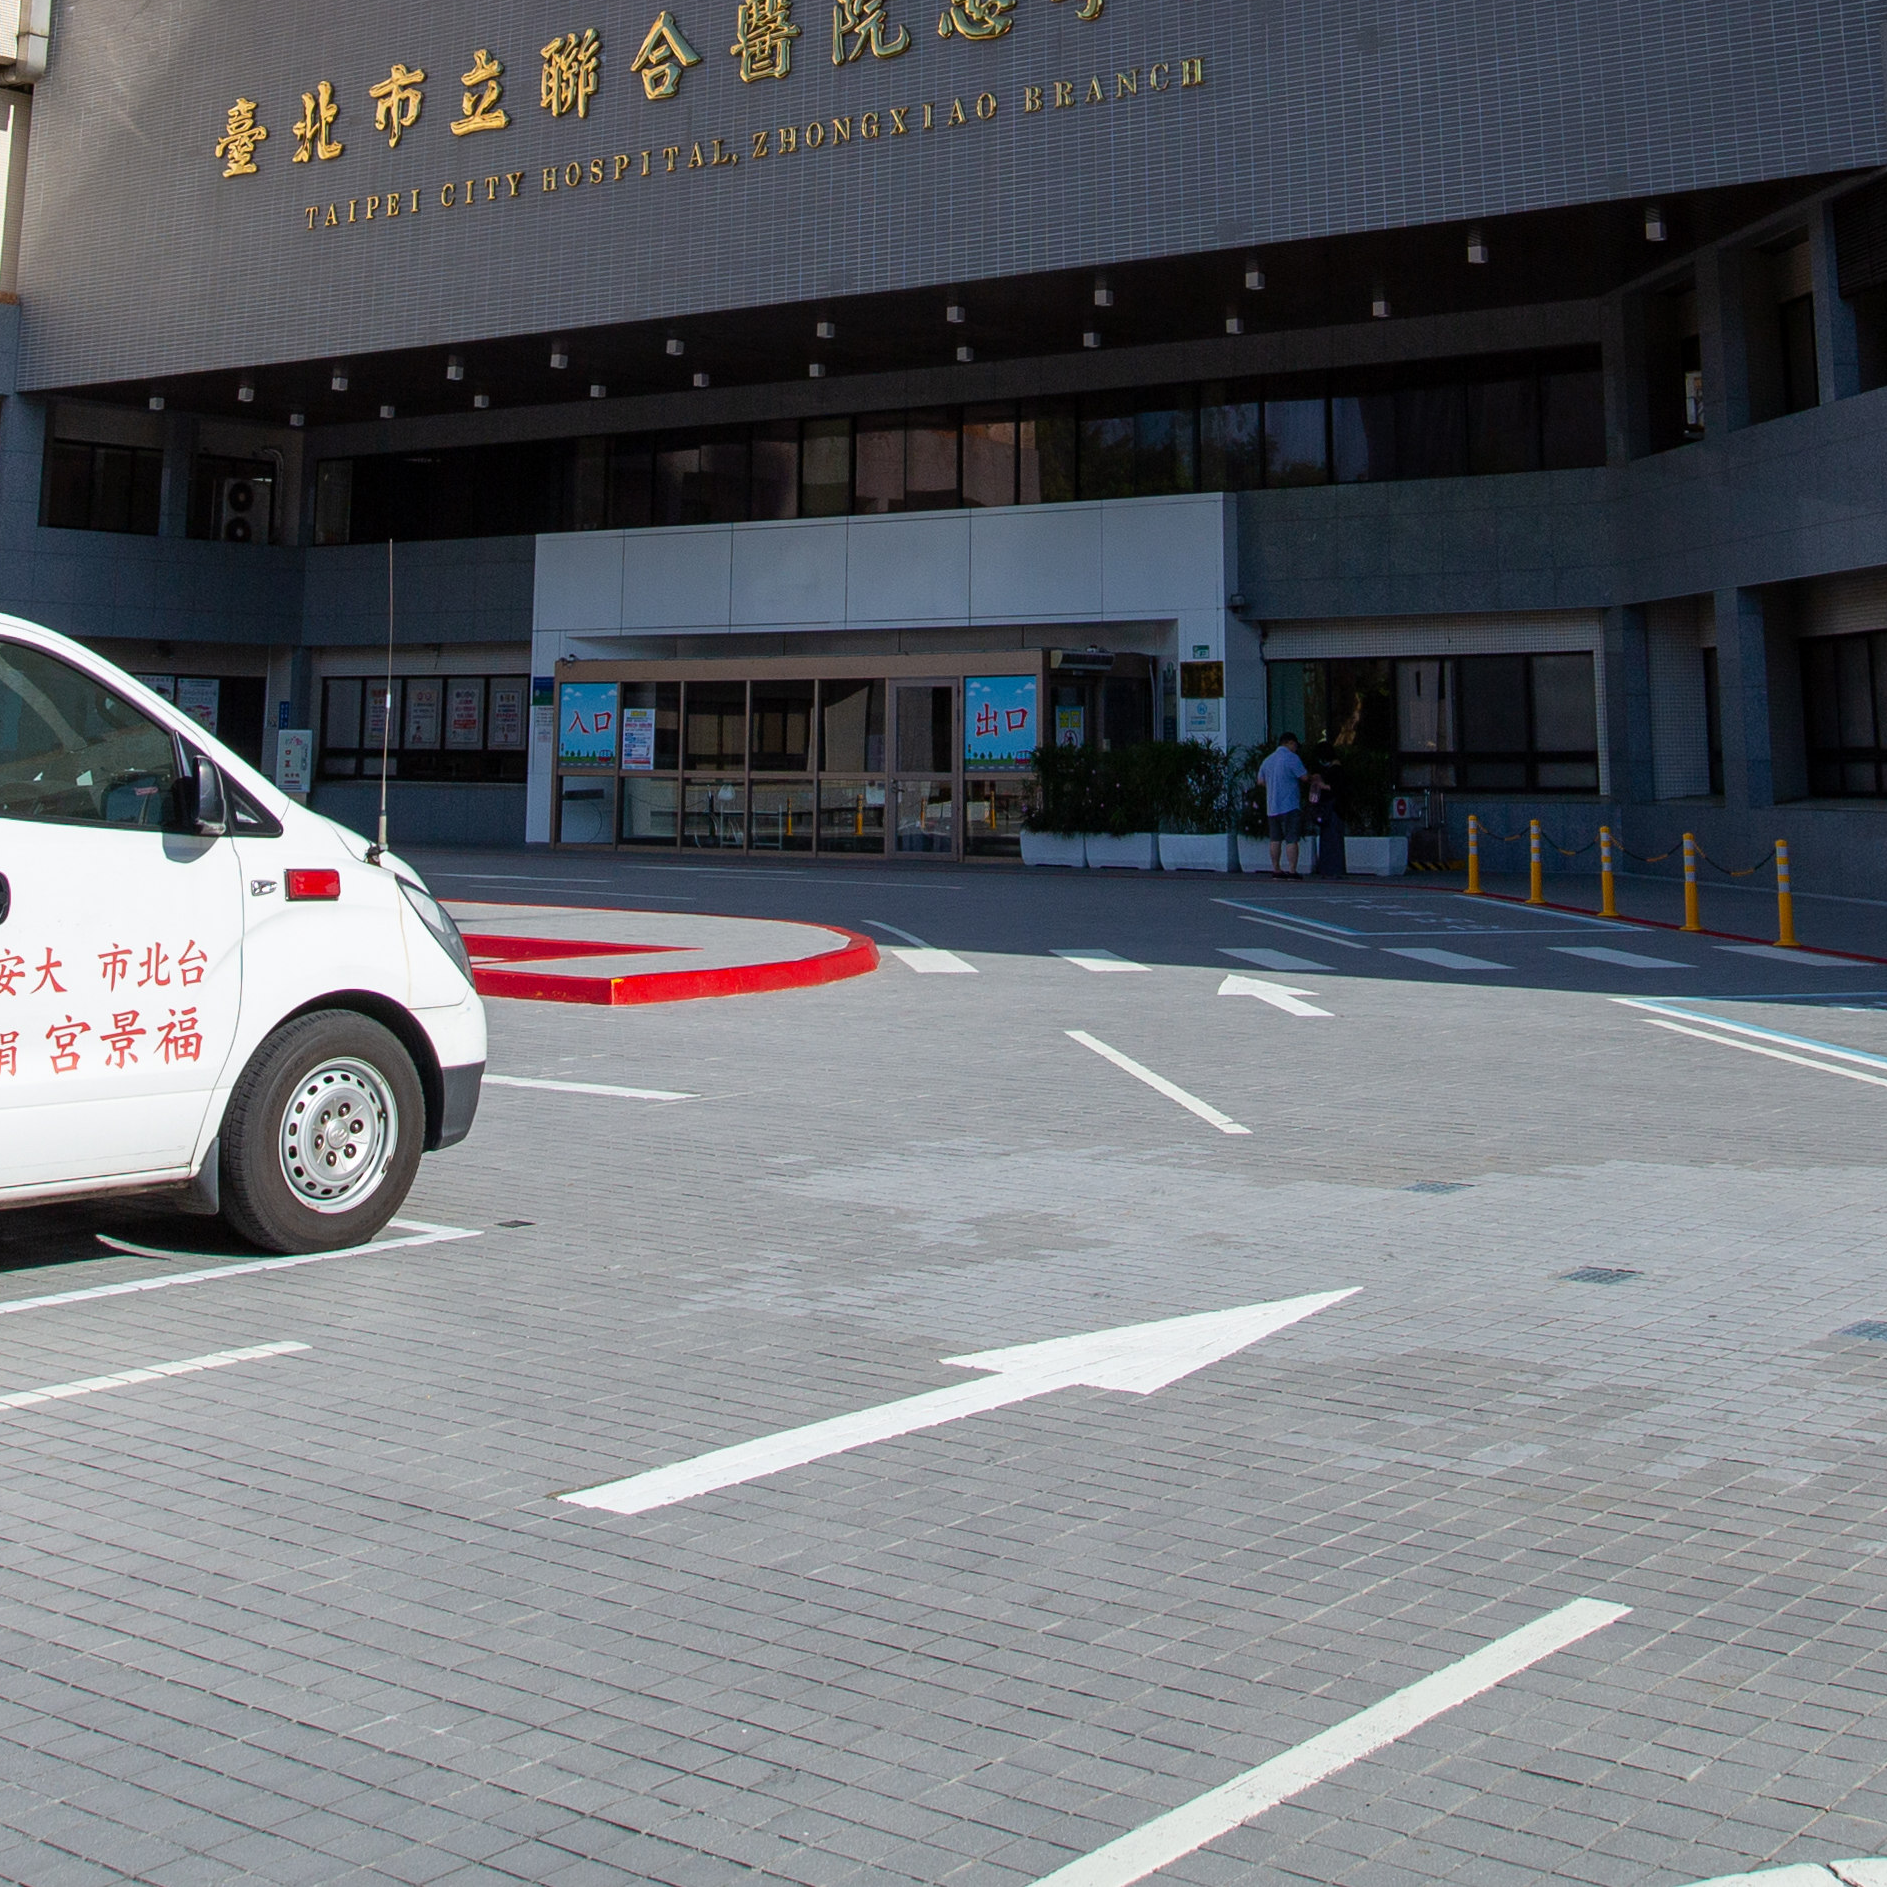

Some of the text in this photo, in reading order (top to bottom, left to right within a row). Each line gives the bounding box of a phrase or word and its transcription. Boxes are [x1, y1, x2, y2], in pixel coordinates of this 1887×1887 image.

[304, 57, 1205, 232] TAIPEI CITY HOSPITAL, ZHONGXIAO BRANCH
[566, 710, 614, 735] 入口
[974, 701, 1029, 739] 出口
